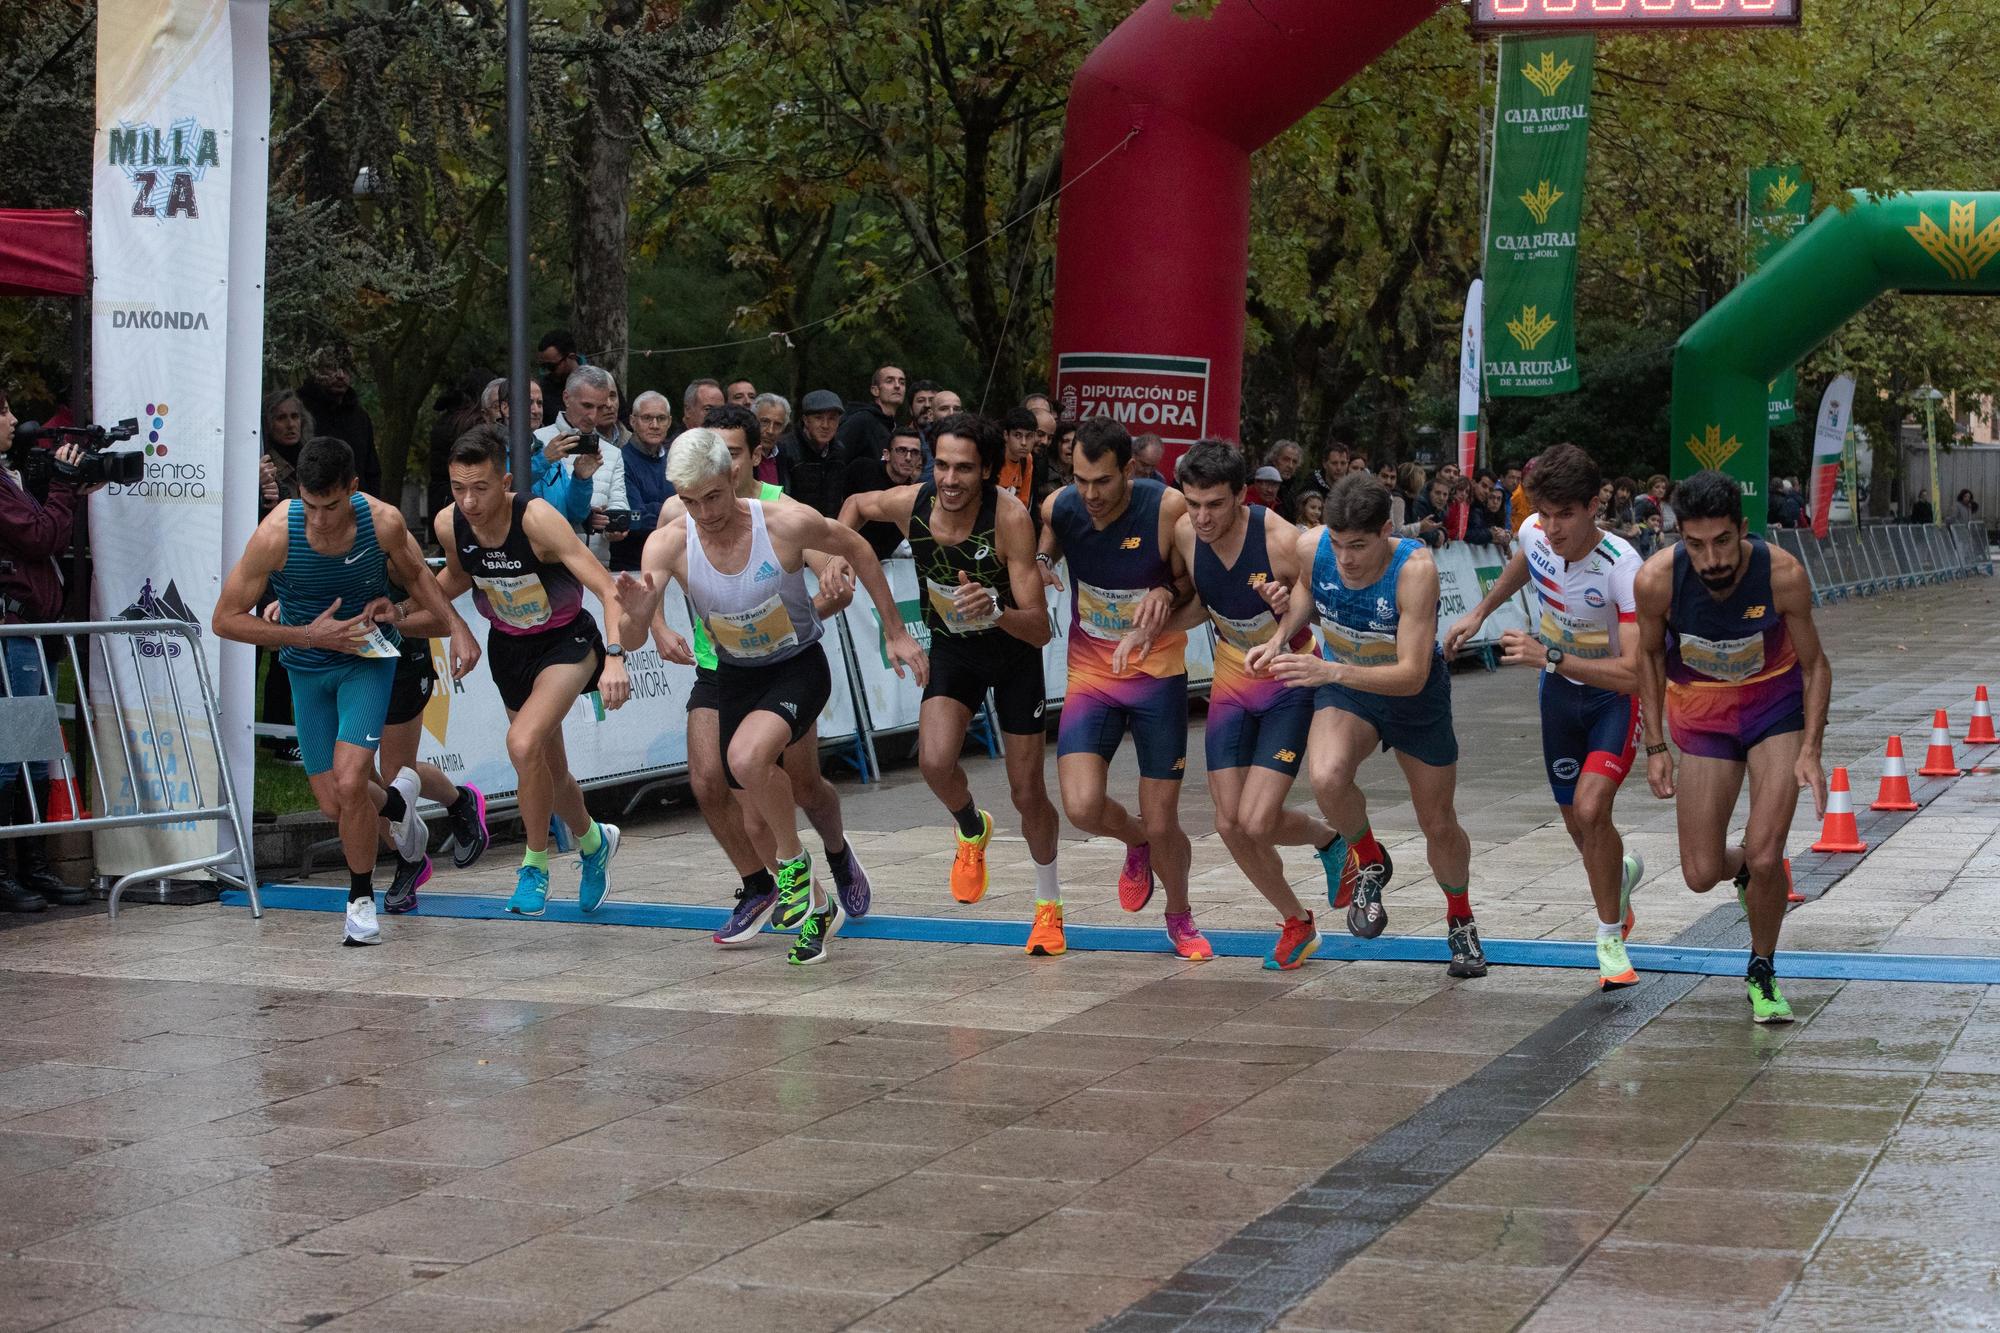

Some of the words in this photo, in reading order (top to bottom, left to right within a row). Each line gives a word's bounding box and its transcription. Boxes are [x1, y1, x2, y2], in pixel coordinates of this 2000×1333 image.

[1504, 107, 1541, 123] CAJA
[1542, 104, 1588, 121] RURAL
[1522, 126, 1535, 134] DE
[1538, 123, 1570, 133] ZAMORA
[109, 128, 220, 167] MILLA
[132, 171, 199, 219] ZA
[112, 310, 209, 330] DAKONDA
[1520, 357, 1572, 375] RURAL
[1515, 378, 1554, 386] ZAMORA
[1081, 385, 1173, 401] DIPUTACIÓN
[1176, 389, 1198, 402] DE
[1079, 401, 1197, 427] ZAMORA
[1531, 551, 1556, 576] aula
